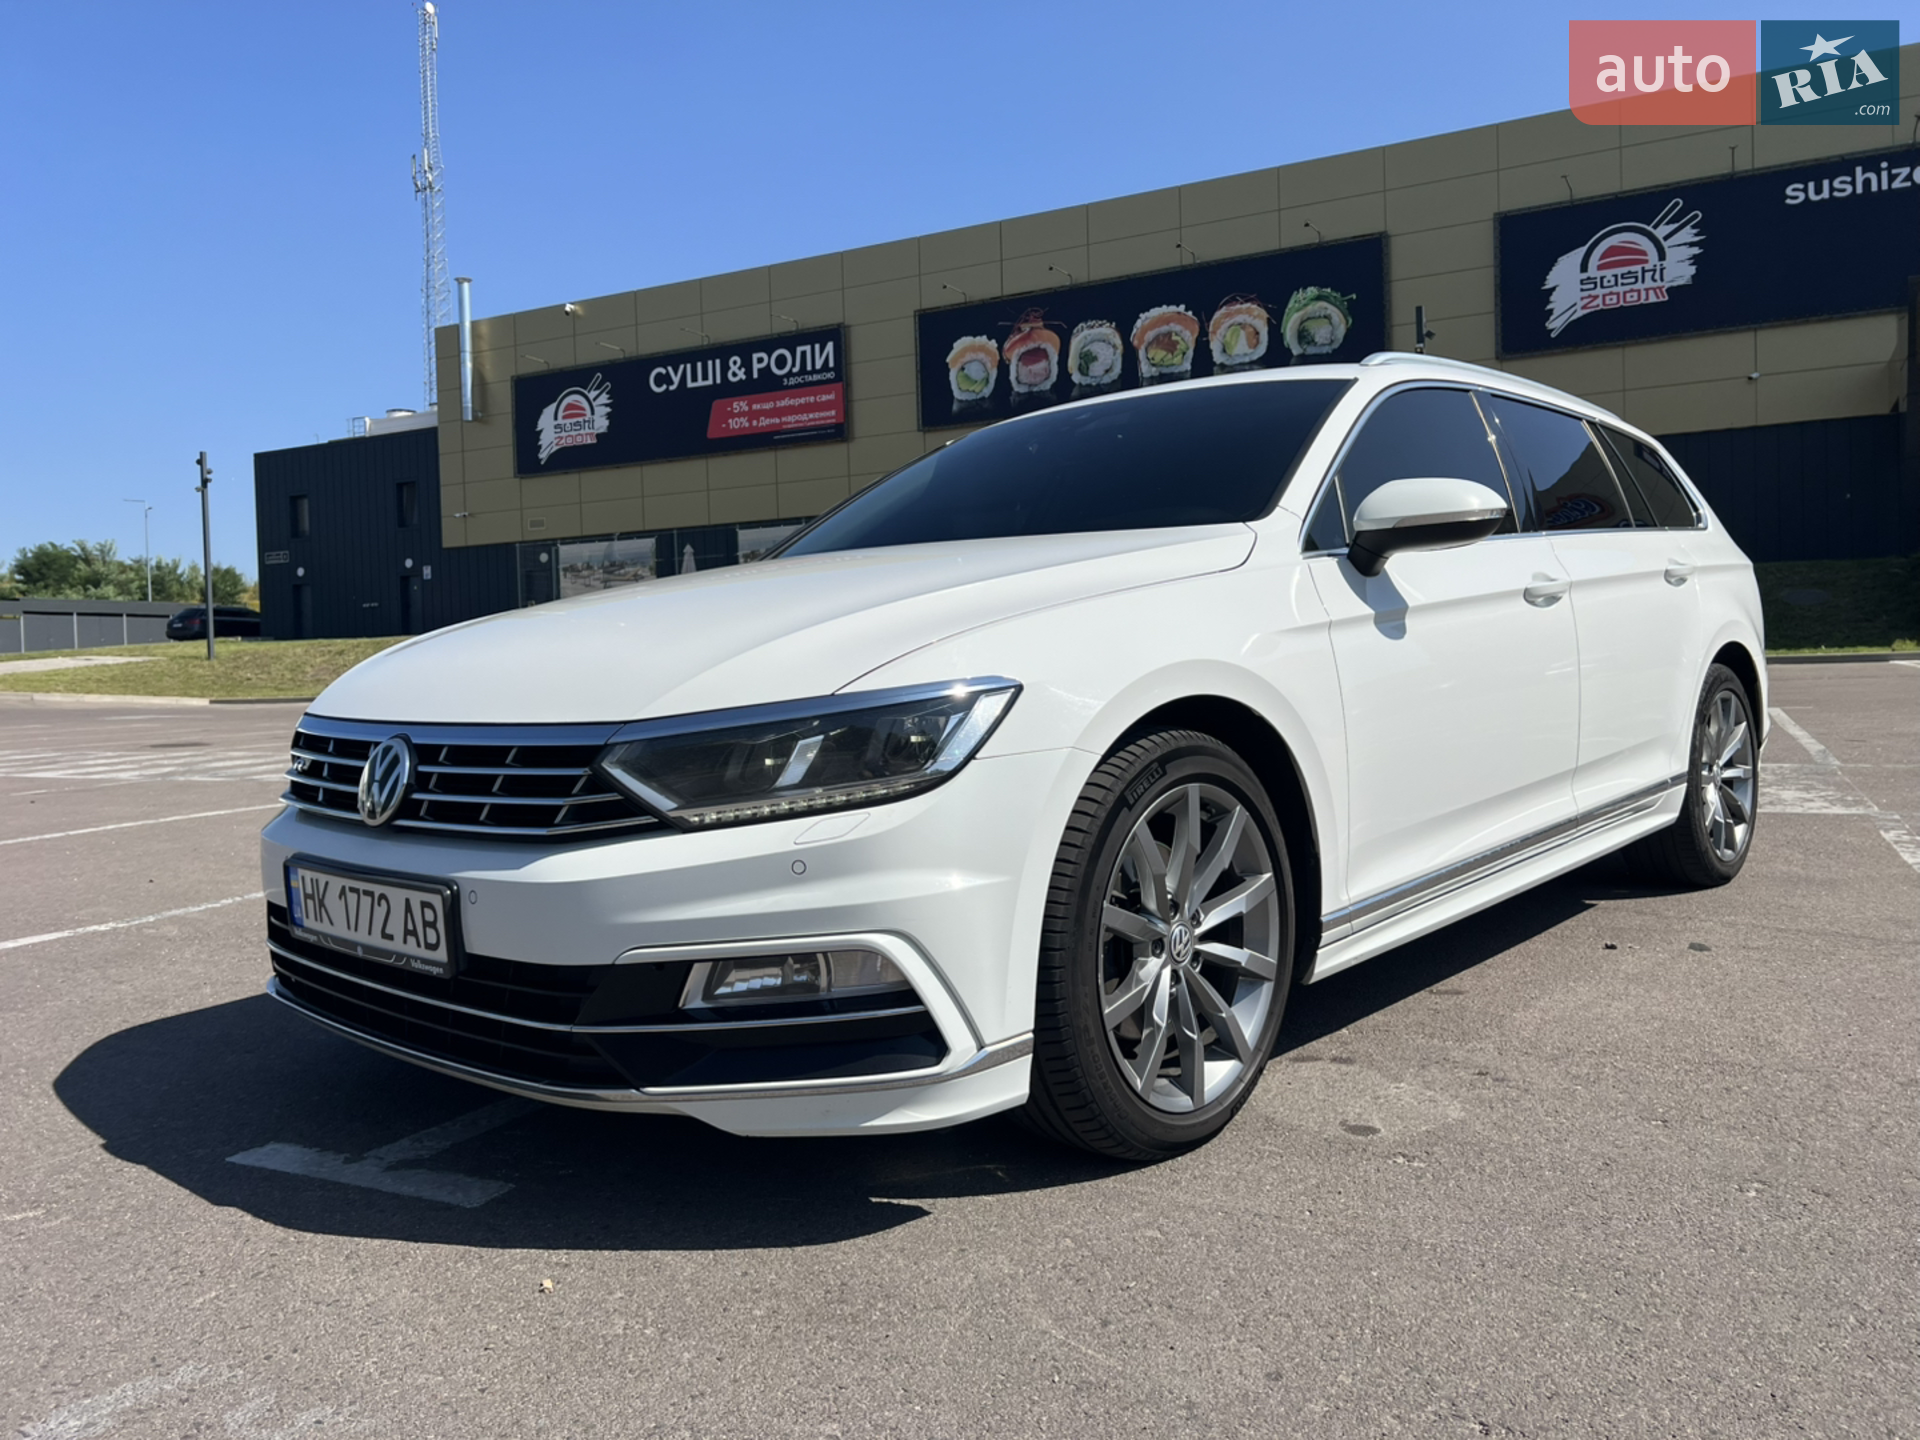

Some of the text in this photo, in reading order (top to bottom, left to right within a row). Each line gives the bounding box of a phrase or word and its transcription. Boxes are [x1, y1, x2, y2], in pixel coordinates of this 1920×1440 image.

[648, 340, 835, 393] СУШІ & РОЛИ
[788, 371, 836, 386] ДОСТАВКОЮ
[301, 875, 441, 951] HK 1772 AB
[410, 958, 444, 975] Volkswagen
